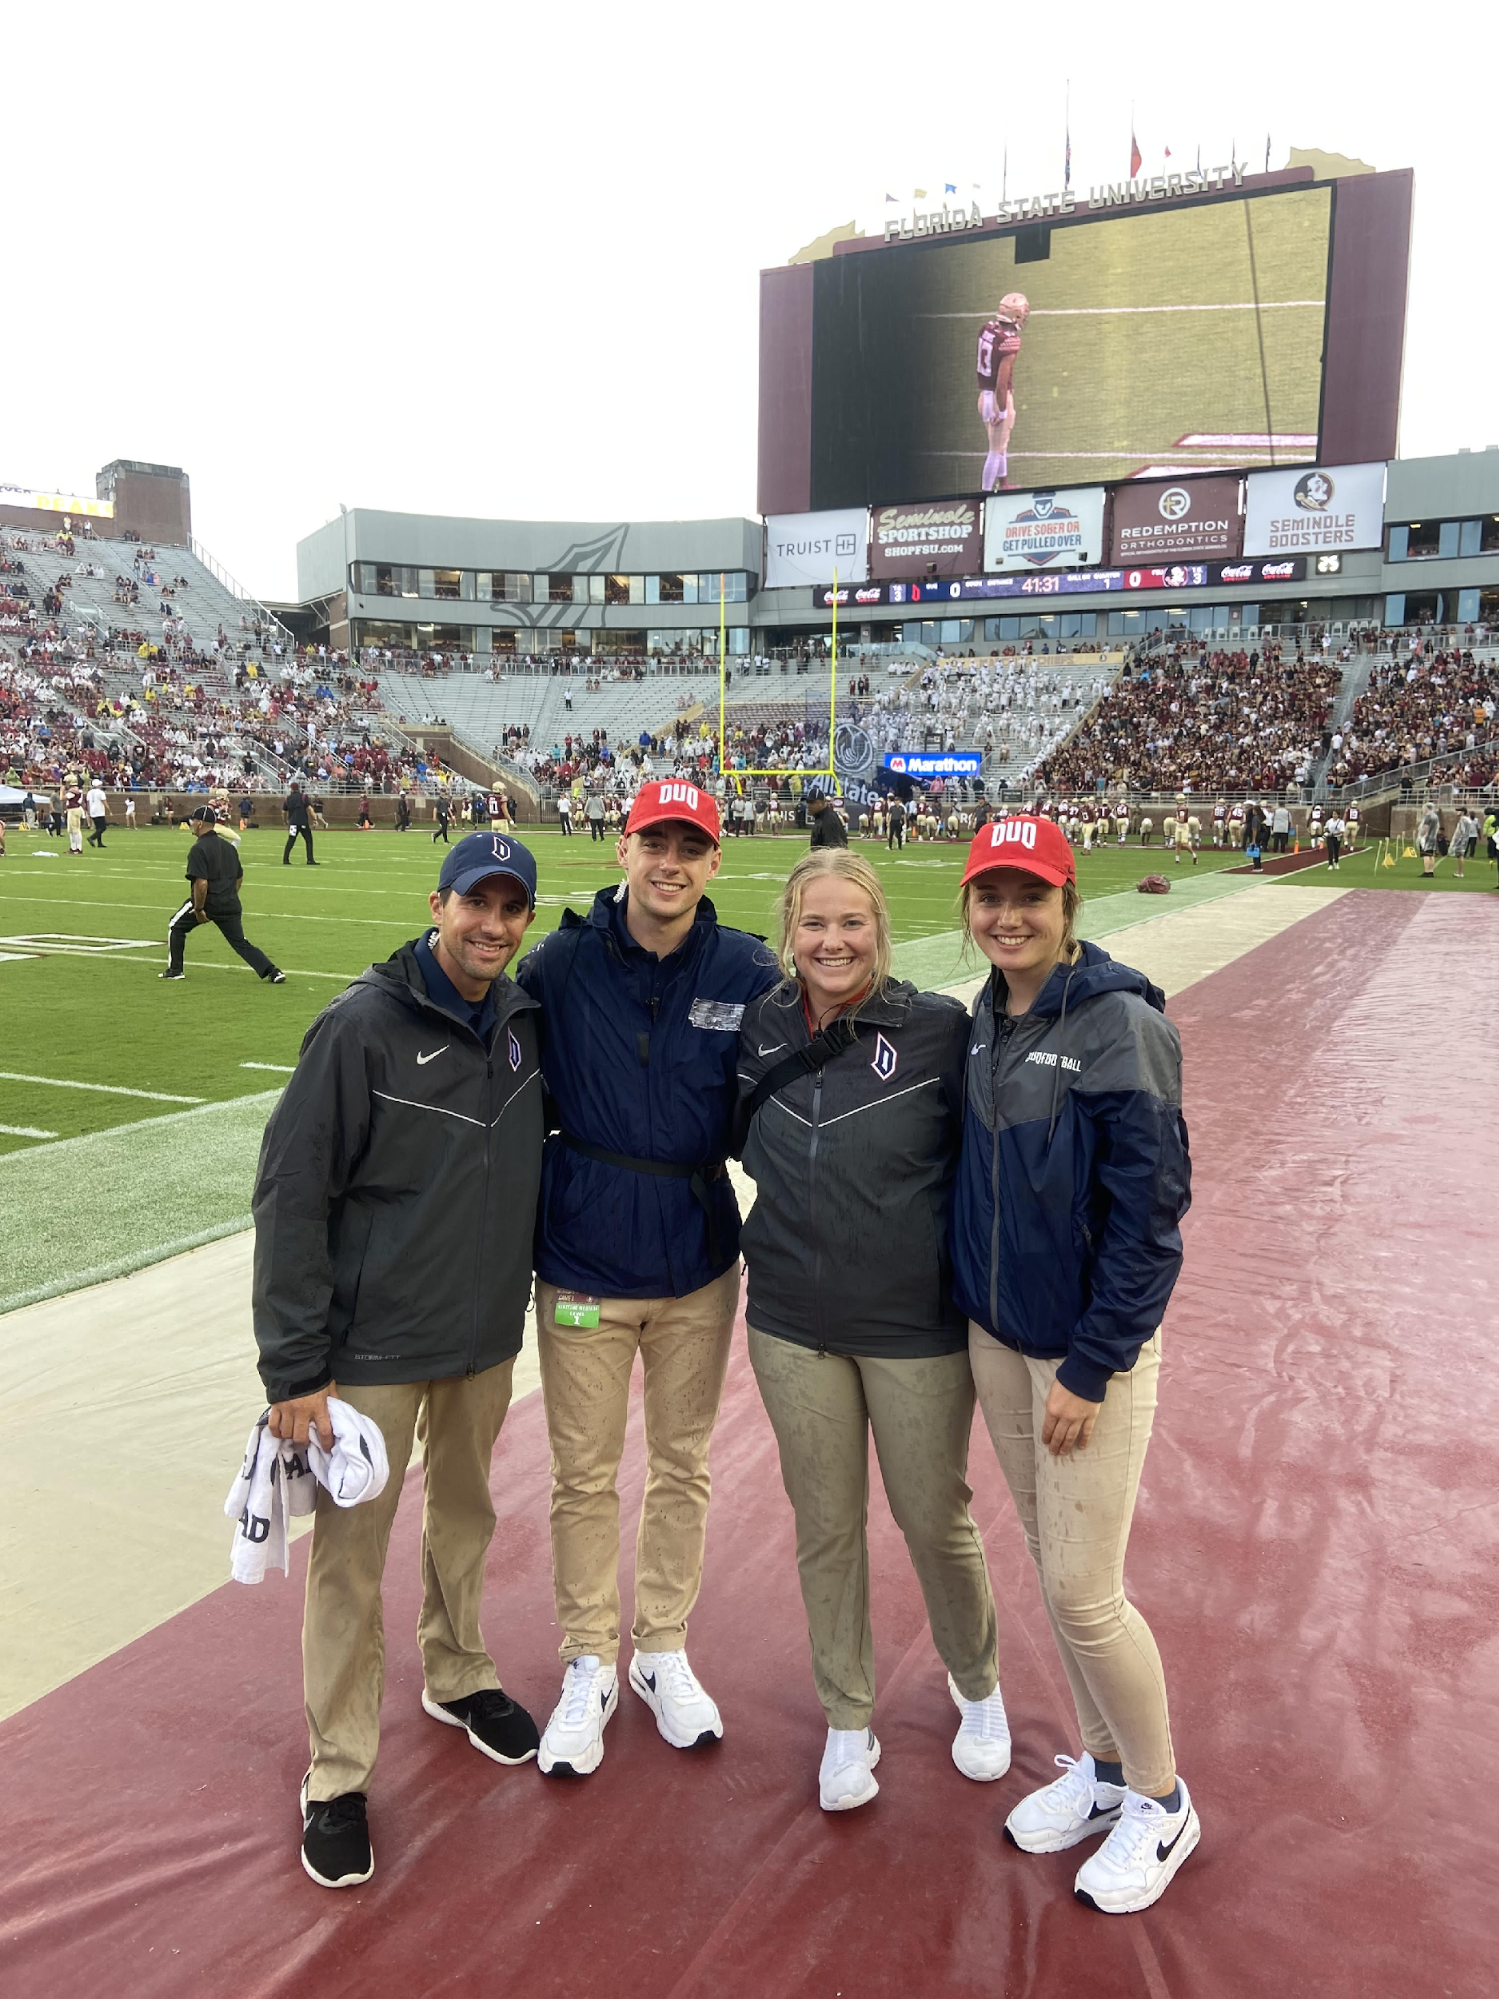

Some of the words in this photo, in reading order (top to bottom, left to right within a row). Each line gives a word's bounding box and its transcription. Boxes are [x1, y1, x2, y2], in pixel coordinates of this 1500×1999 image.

[884, 206, 983, 243] FLORIDA
[997, 190, 1076, 224] STATE
[1088, 162, 1248, 209] UNIVERSITY
[877, 504, 975, 532] Seminole
[1270, 514, 1355, 533] SEMINOLE
[878, 525, 973, 544] SPORTSHOP
[1005, 525, 1032, 538] DRIVE
[1034, 522, 1065, 536] SOBER
[1067, 521, 1079, 533] OR
[1121, 520, 1228, 538] REDEMPTION
[1003, 540, 1020, 552] GET
[1021, 536, 1057, 550] PULLED
[1057, 534, 1081, 547] OVER
[1121, 535, 1228, 550] ORTHODONTICS
[1269, 529, 1354, 548] BOOSTERS
[777, 540, 832, 557] TRUIST
[884, 544, 963, 557] SHOPFSU.COM
[1022, 577, 1060, 592] 41:31
[1129, 572, 1141, 587] 0
[1193, 573, 1202, 584] 3
[894, 592, 902, 602] 3
[950, 583, 960, 598] 0
[908, 758, 977, 772] Marathon
[991, 821, 1037, 850] DUQ
